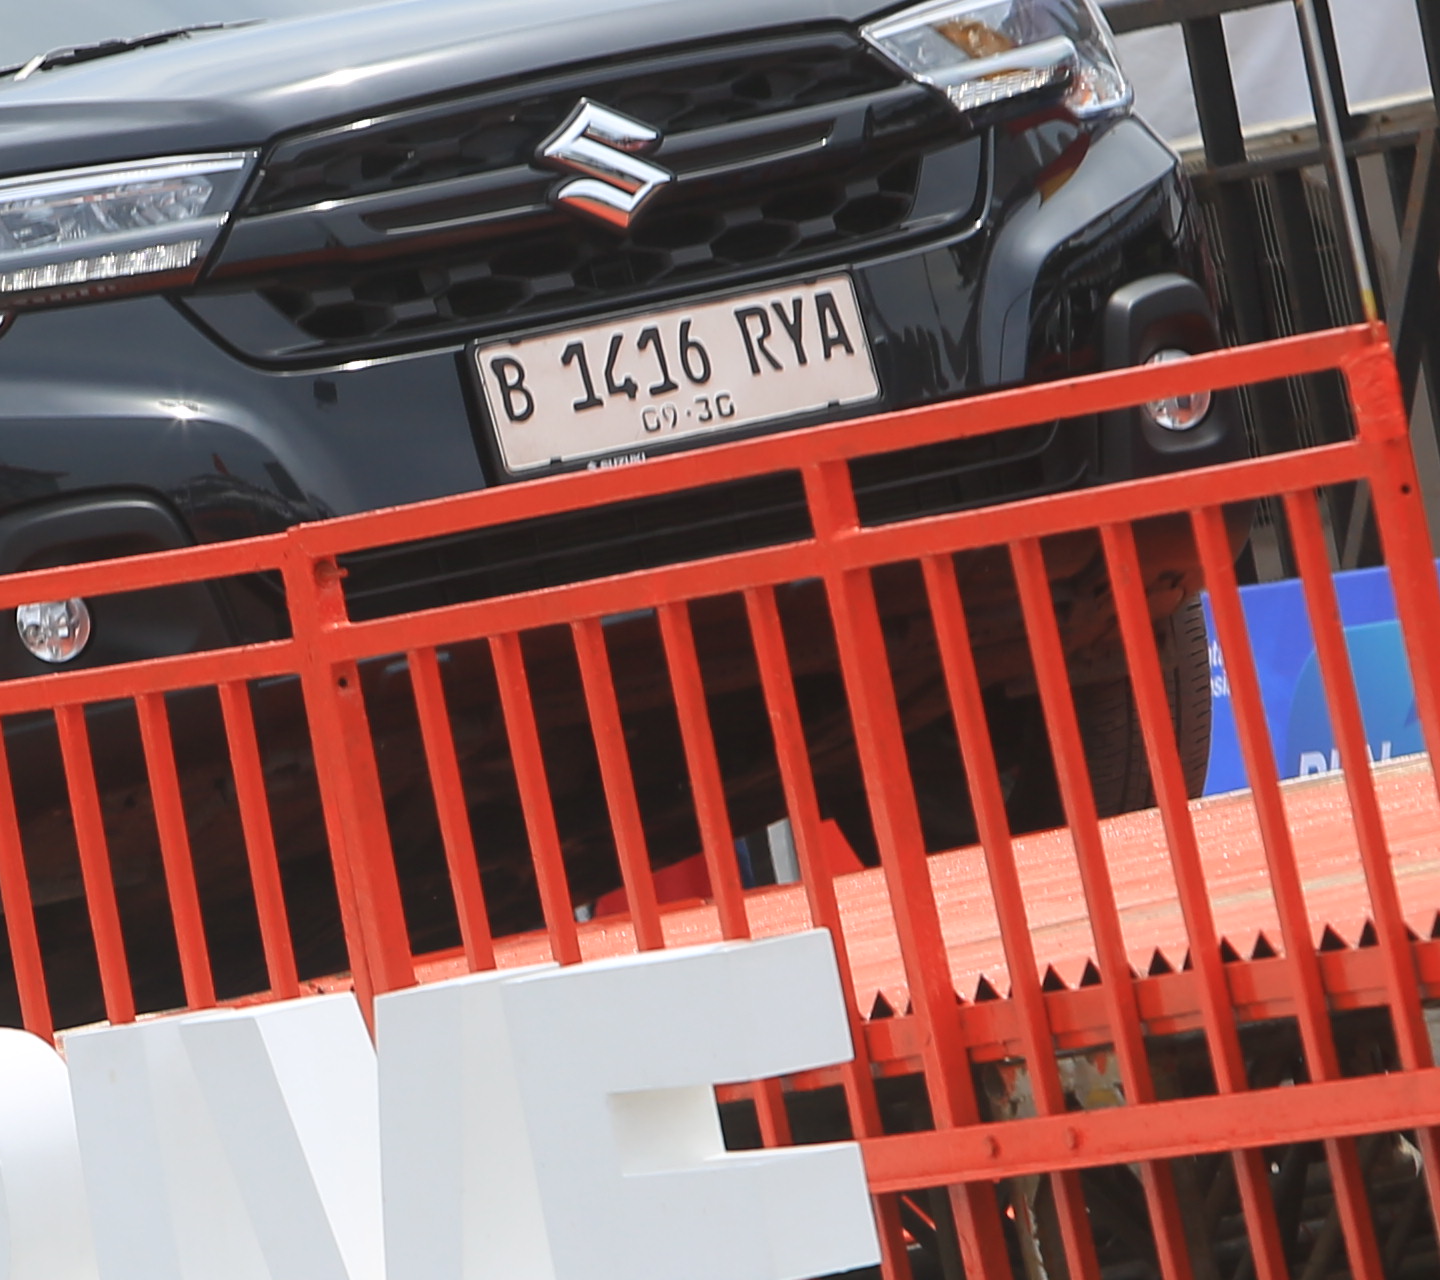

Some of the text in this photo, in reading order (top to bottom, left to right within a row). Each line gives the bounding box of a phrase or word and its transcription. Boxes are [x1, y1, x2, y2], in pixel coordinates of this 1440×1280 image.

[490, 290, 856, 424] B 1416 RYA
